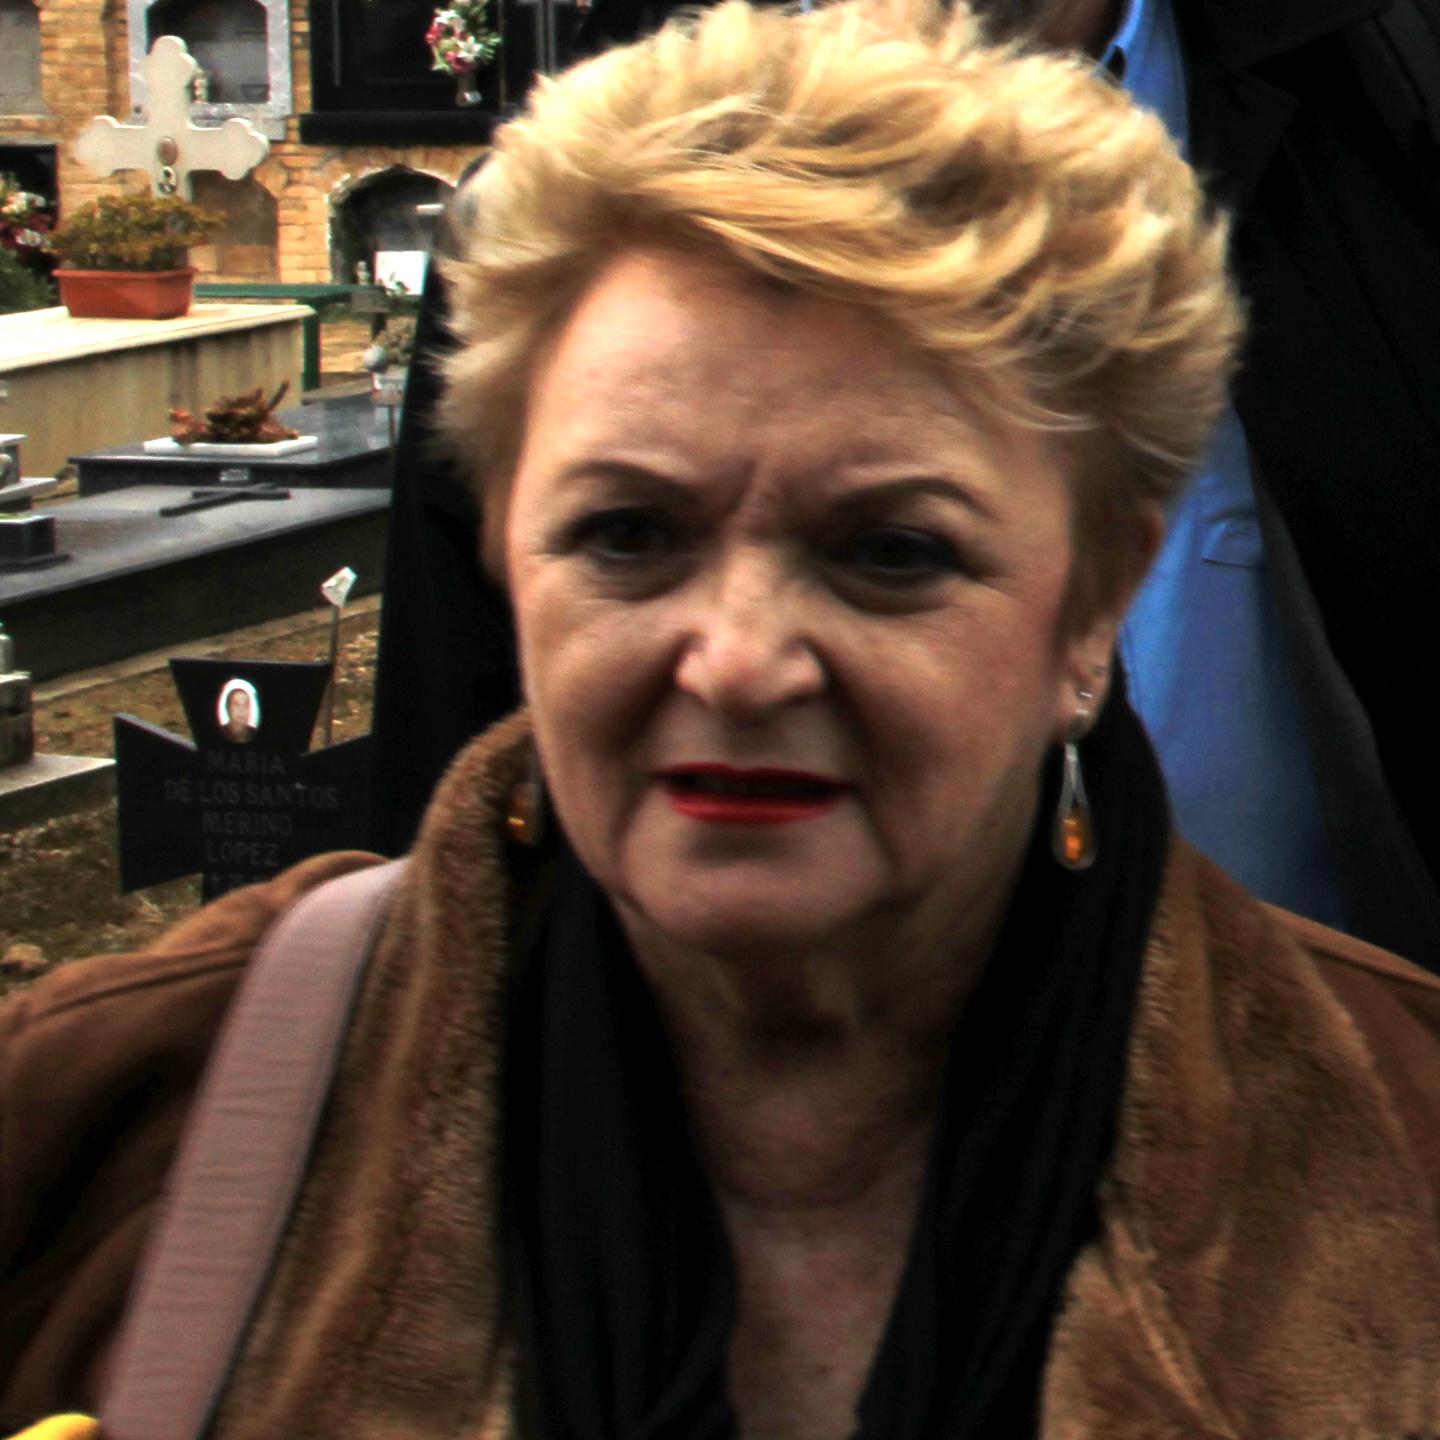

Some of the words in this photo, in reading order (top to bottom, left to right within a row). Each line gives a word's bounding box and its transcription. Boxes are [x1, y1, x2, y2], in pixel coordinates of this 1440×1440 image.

[206, 749, 286, 775] MARIA
[164, 779, 192, 802] DE
[199, 781, 241, 804] LOS
[246, 783, 338, 808] SANTOS
[201, 811, 292, 837] MERINO
[207, 840, 279, 866] LOPEZ
